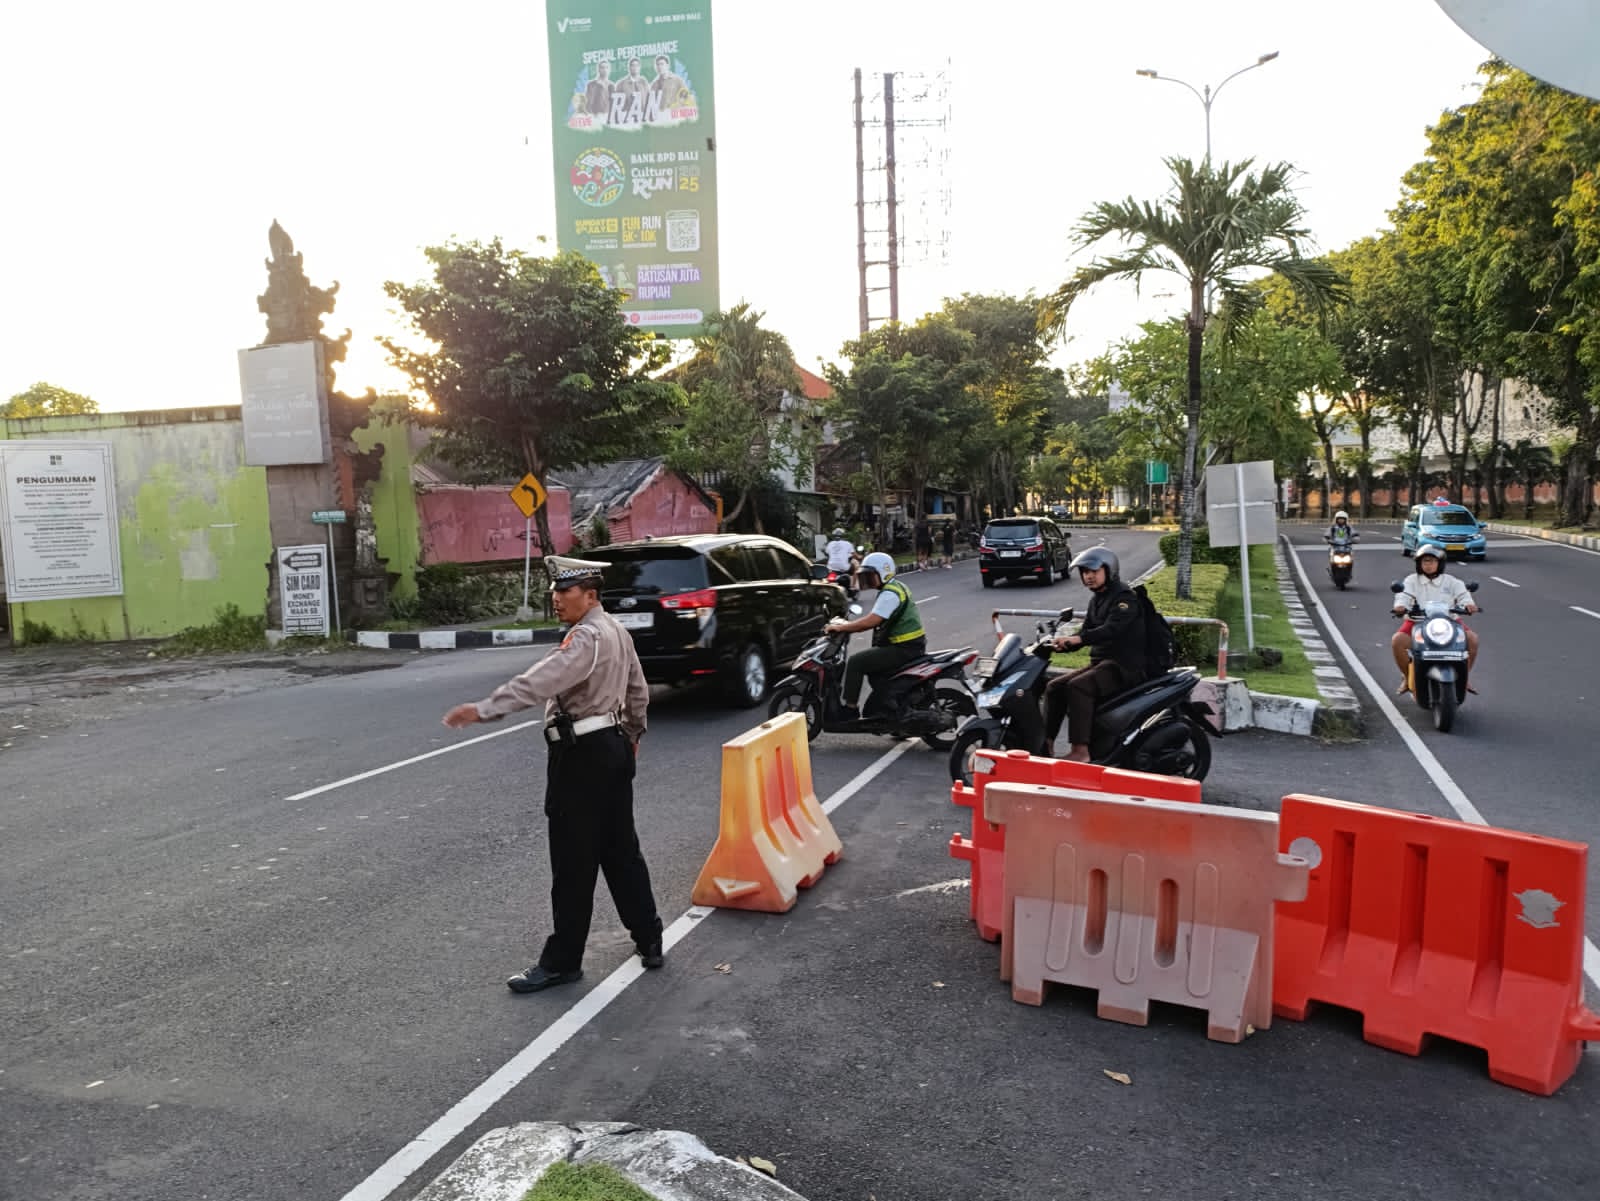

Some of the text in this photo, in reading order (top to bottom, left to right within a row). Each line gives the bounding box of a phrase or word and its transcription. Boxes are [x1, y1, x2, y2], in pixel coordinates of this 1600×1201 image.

[582, 40, 679, 64] SPECIAL PERFORMANCE
[608, 91, 663, 124] RAN
[631, 151, 698, 164] BANK BPD BALI
[631, 166, 673, 178] Culture
[631, 177, 673, 200] RUN
[679, 177, 699, 192] 25
[641, 215, 662, 230] RUN
[638, 268, 700, 283] RATUSAN JUTA
[638, 285, 671, 299] RUPIAH
[16, 476, 97, 484] PENGUMUMAN
[286, 574, 320, 591] SIM CARD
[287, 600, 320, 608] EXCHANGE
